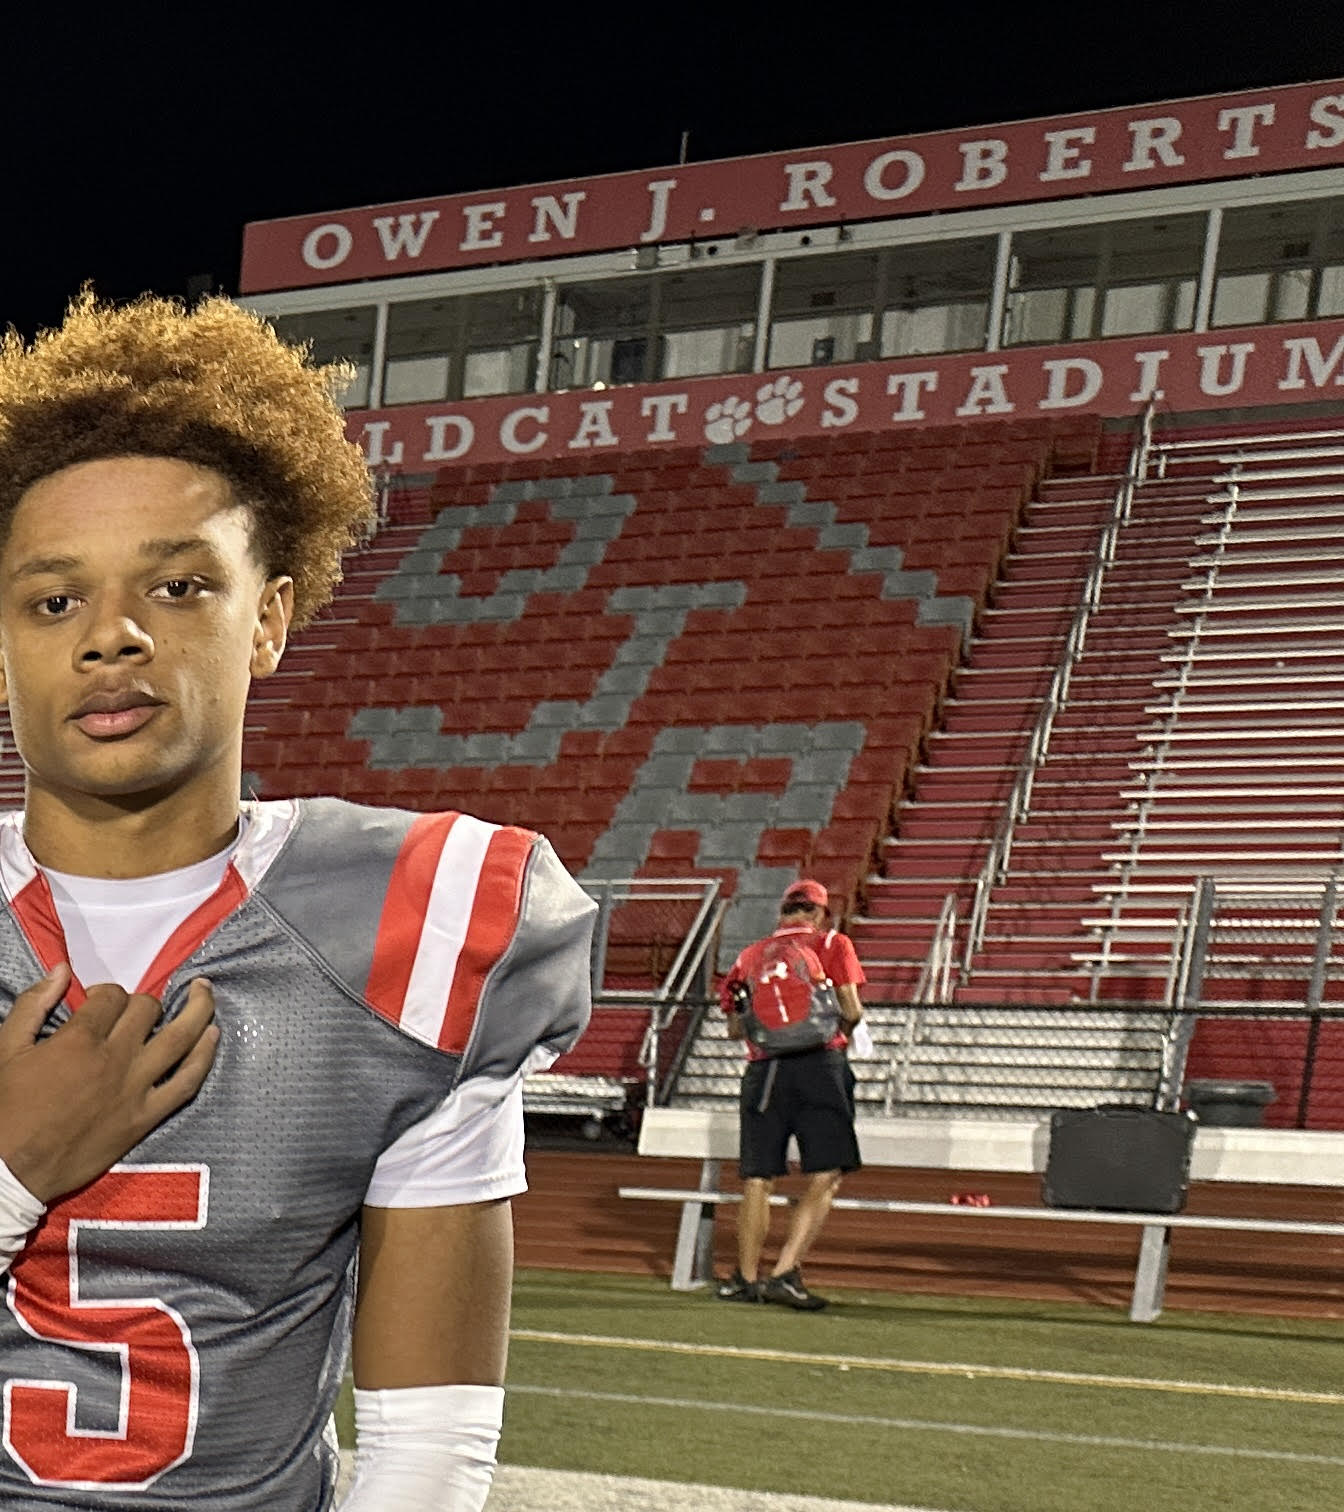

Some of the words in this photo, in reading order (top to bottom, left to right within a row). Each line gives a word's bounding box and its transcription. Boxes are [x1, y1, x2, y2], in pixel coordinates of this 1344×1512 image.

[301, 191, 587, 270] OWEN
[641, 179, 716, 243] J.
[779, 93, 1344, 213] ROBERTS
[362, 393, 689, 467] LDCAT
[820, 336, 1344, 429] STADIUM
[2, 1162, 211, 1492] 5
